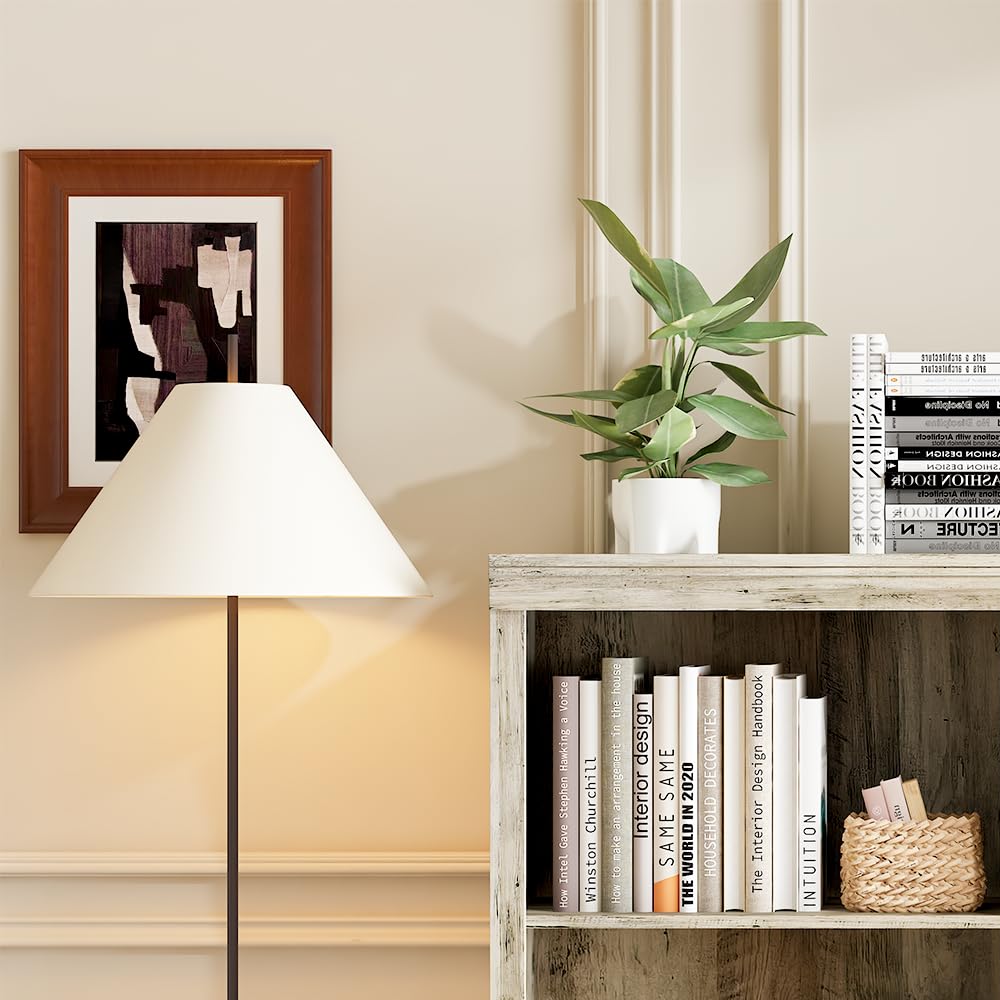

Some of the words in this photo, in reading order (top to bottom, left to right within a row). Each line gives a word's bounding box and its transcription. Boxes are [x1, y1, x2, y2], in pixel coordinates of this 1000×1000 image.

[559, 681, 569, 711] Voice
[752, 676, 763, 736] Handbook
[559, 728, 571, 773] Hawking
[634, 701, 653, 765] design
[704, 709, 717, 787] DECORATES
[659, 749, 674, 800] SAME
[682, 763, 693, 800] 2020
[752, 746, 766, 791] Design
[559, 777, 570, 818] Stephen
[585, 758, 596, 833] Churchill
[634, 771, 649, 838] Interior
[682, 805, 693, 819] IN
[560, 825, 568, 848] Gave
[659, 815, 674, 866] SAME
[682, 824, 693, 876] WORLD
[704, 797, 717, 877] HOUSEHOLD
[752, 801, 763, 861] Interior
[559, 854, 568, 883] Intel
[585, 843, 596, 902] Winston
[752, 871, 763, 893] The
[803, 815, 816, 906] INTUITION
[560, 890, 568, 907] How
[682, 880, 693, 907] THE
